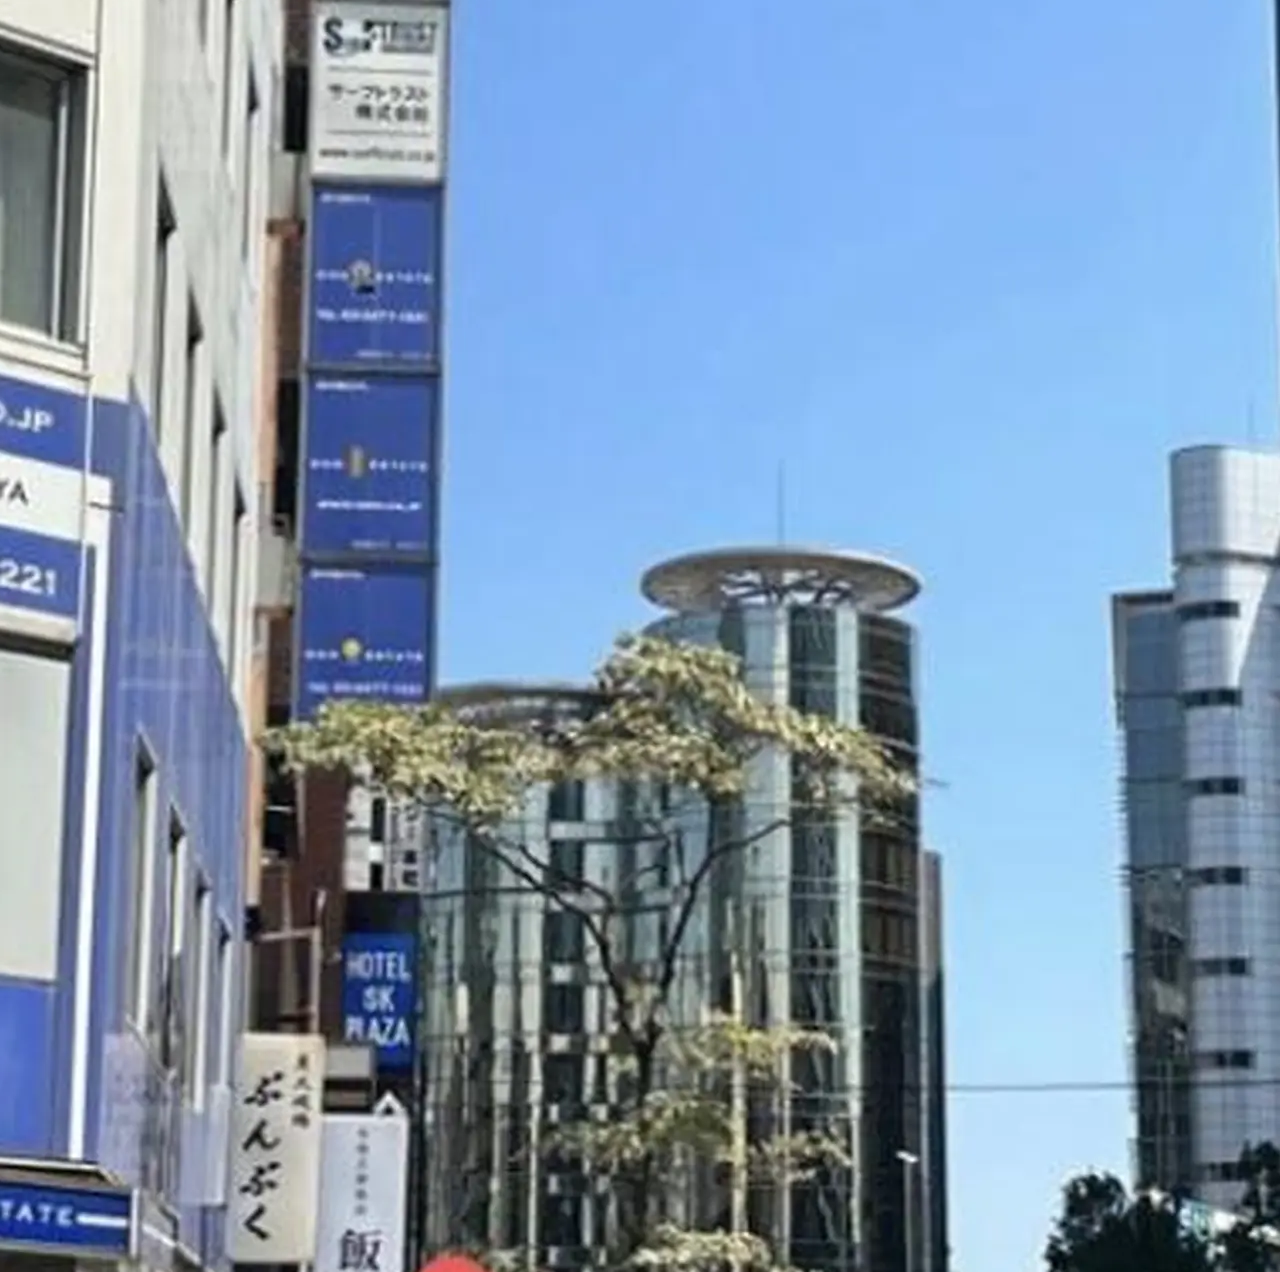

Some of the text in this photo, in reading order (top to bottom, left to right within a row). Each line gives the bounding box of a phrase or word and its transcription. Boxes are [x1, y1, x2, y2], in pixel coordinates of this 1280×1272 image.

[346, 949, 412, 984] HOTEL
[361, 985, 395, 1014] SK
[344, 1012, 411, 1048] PLAZA
[238, 1071, 284, 1242] ぶんぶく
